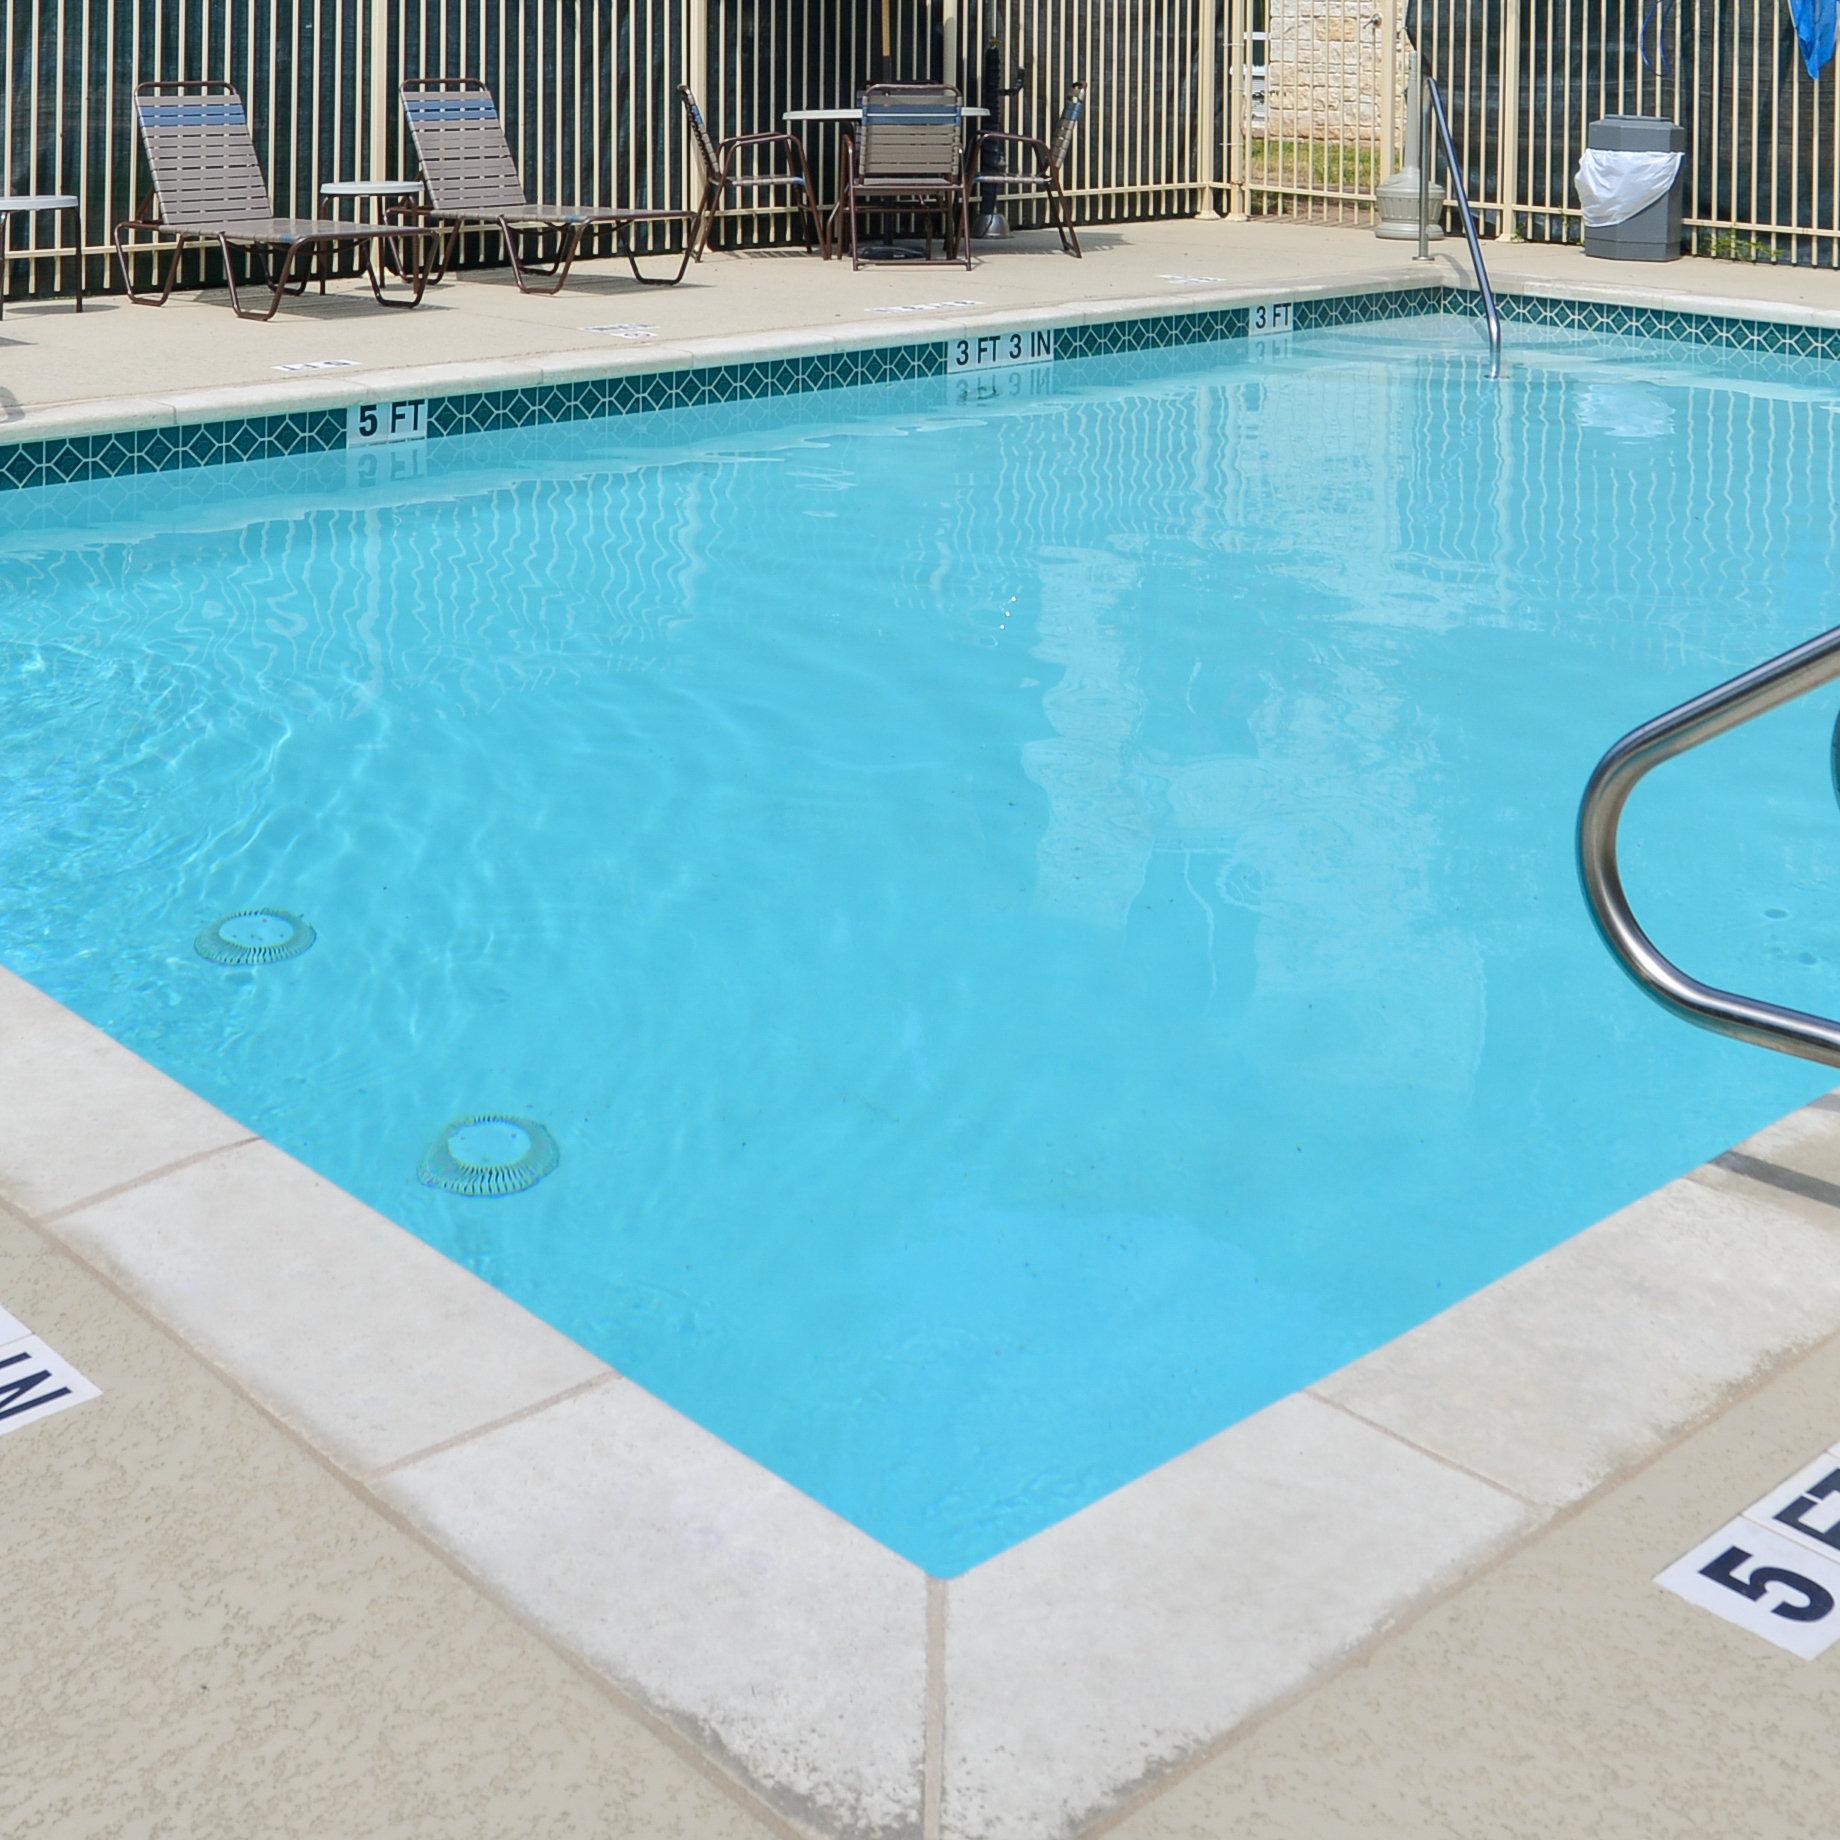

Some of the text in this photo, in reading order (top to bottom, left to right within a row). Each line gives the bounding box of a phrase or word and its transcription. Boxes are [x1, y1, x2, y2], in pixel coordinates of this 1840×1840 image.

[1255, 302, 1292, 329] 3 FT
[956, 329, 1051, 366] 3 FT 3 IN
[358, 399, 425, 437] 5 FT
[1697, 1545, 1836, 1623] 5
